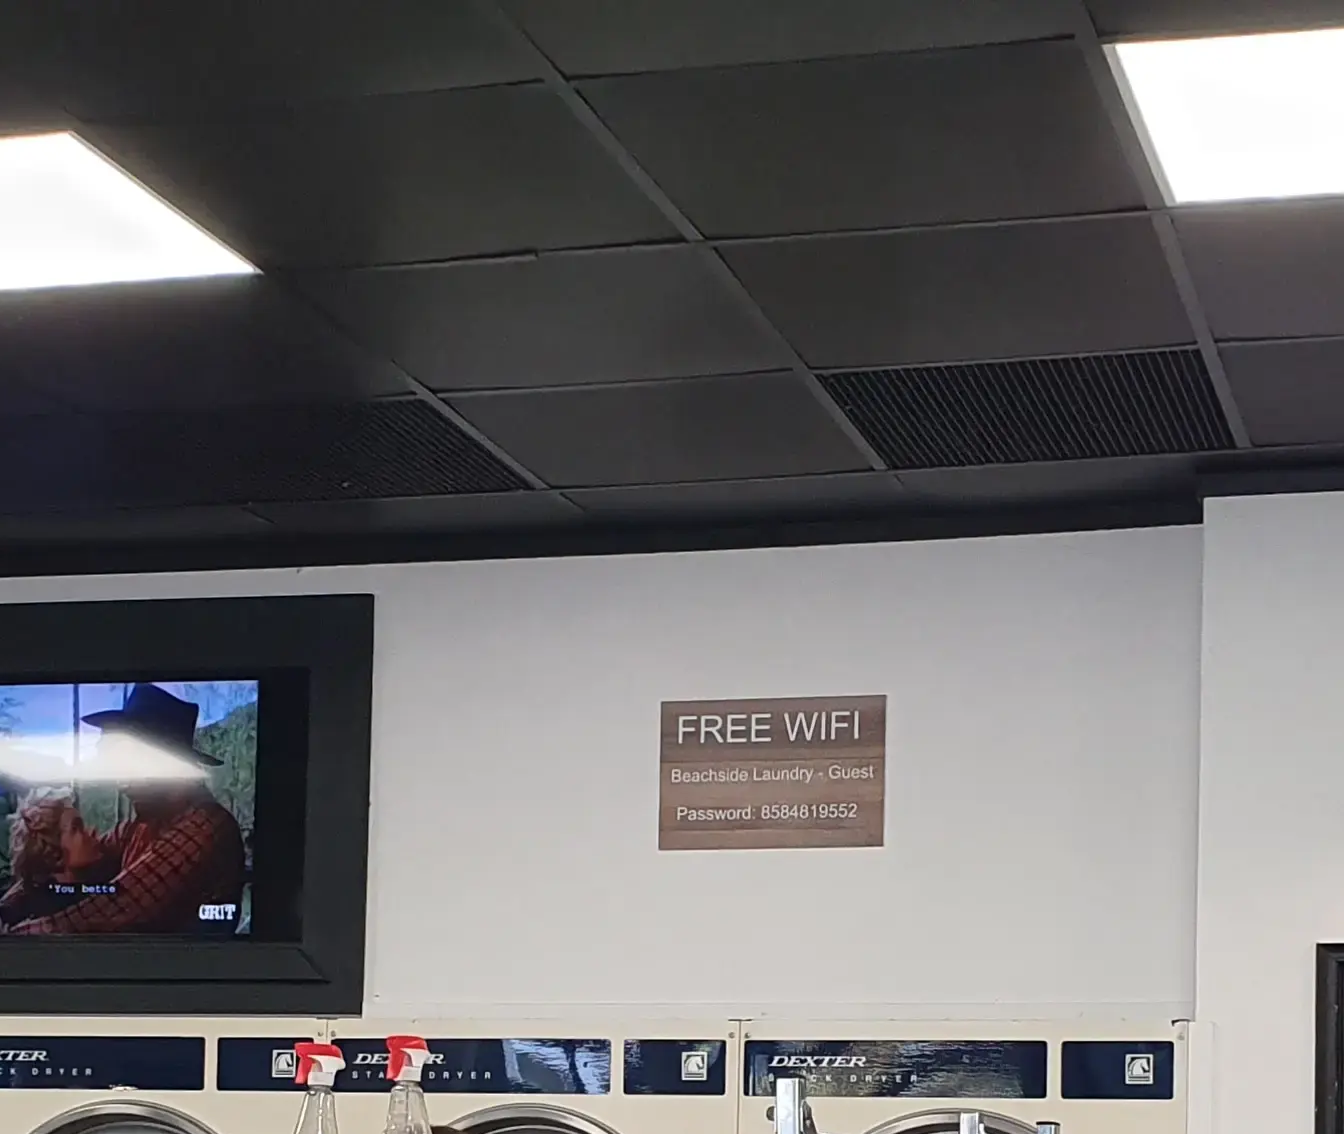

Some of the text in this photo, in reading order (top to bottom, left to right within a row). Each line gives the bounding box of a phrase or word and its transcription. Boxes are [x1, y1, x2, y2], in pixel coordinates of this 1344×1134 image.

[677, 710, 860, 744] FREE WIFI
[671, 768, 749, 784] Beachside
[752, 766, 815, 784] Laundry
[828, 764, 874, 780] Guest
[676, 803, 858, 821] Password: 8584819552
[198, 903, 236, 920] GRIT
[768, 1056, 866, 1067] DEXTER
[31, 1068, 93, 1076] DRYER
[428, 1071, 492, 1079] DRYER
